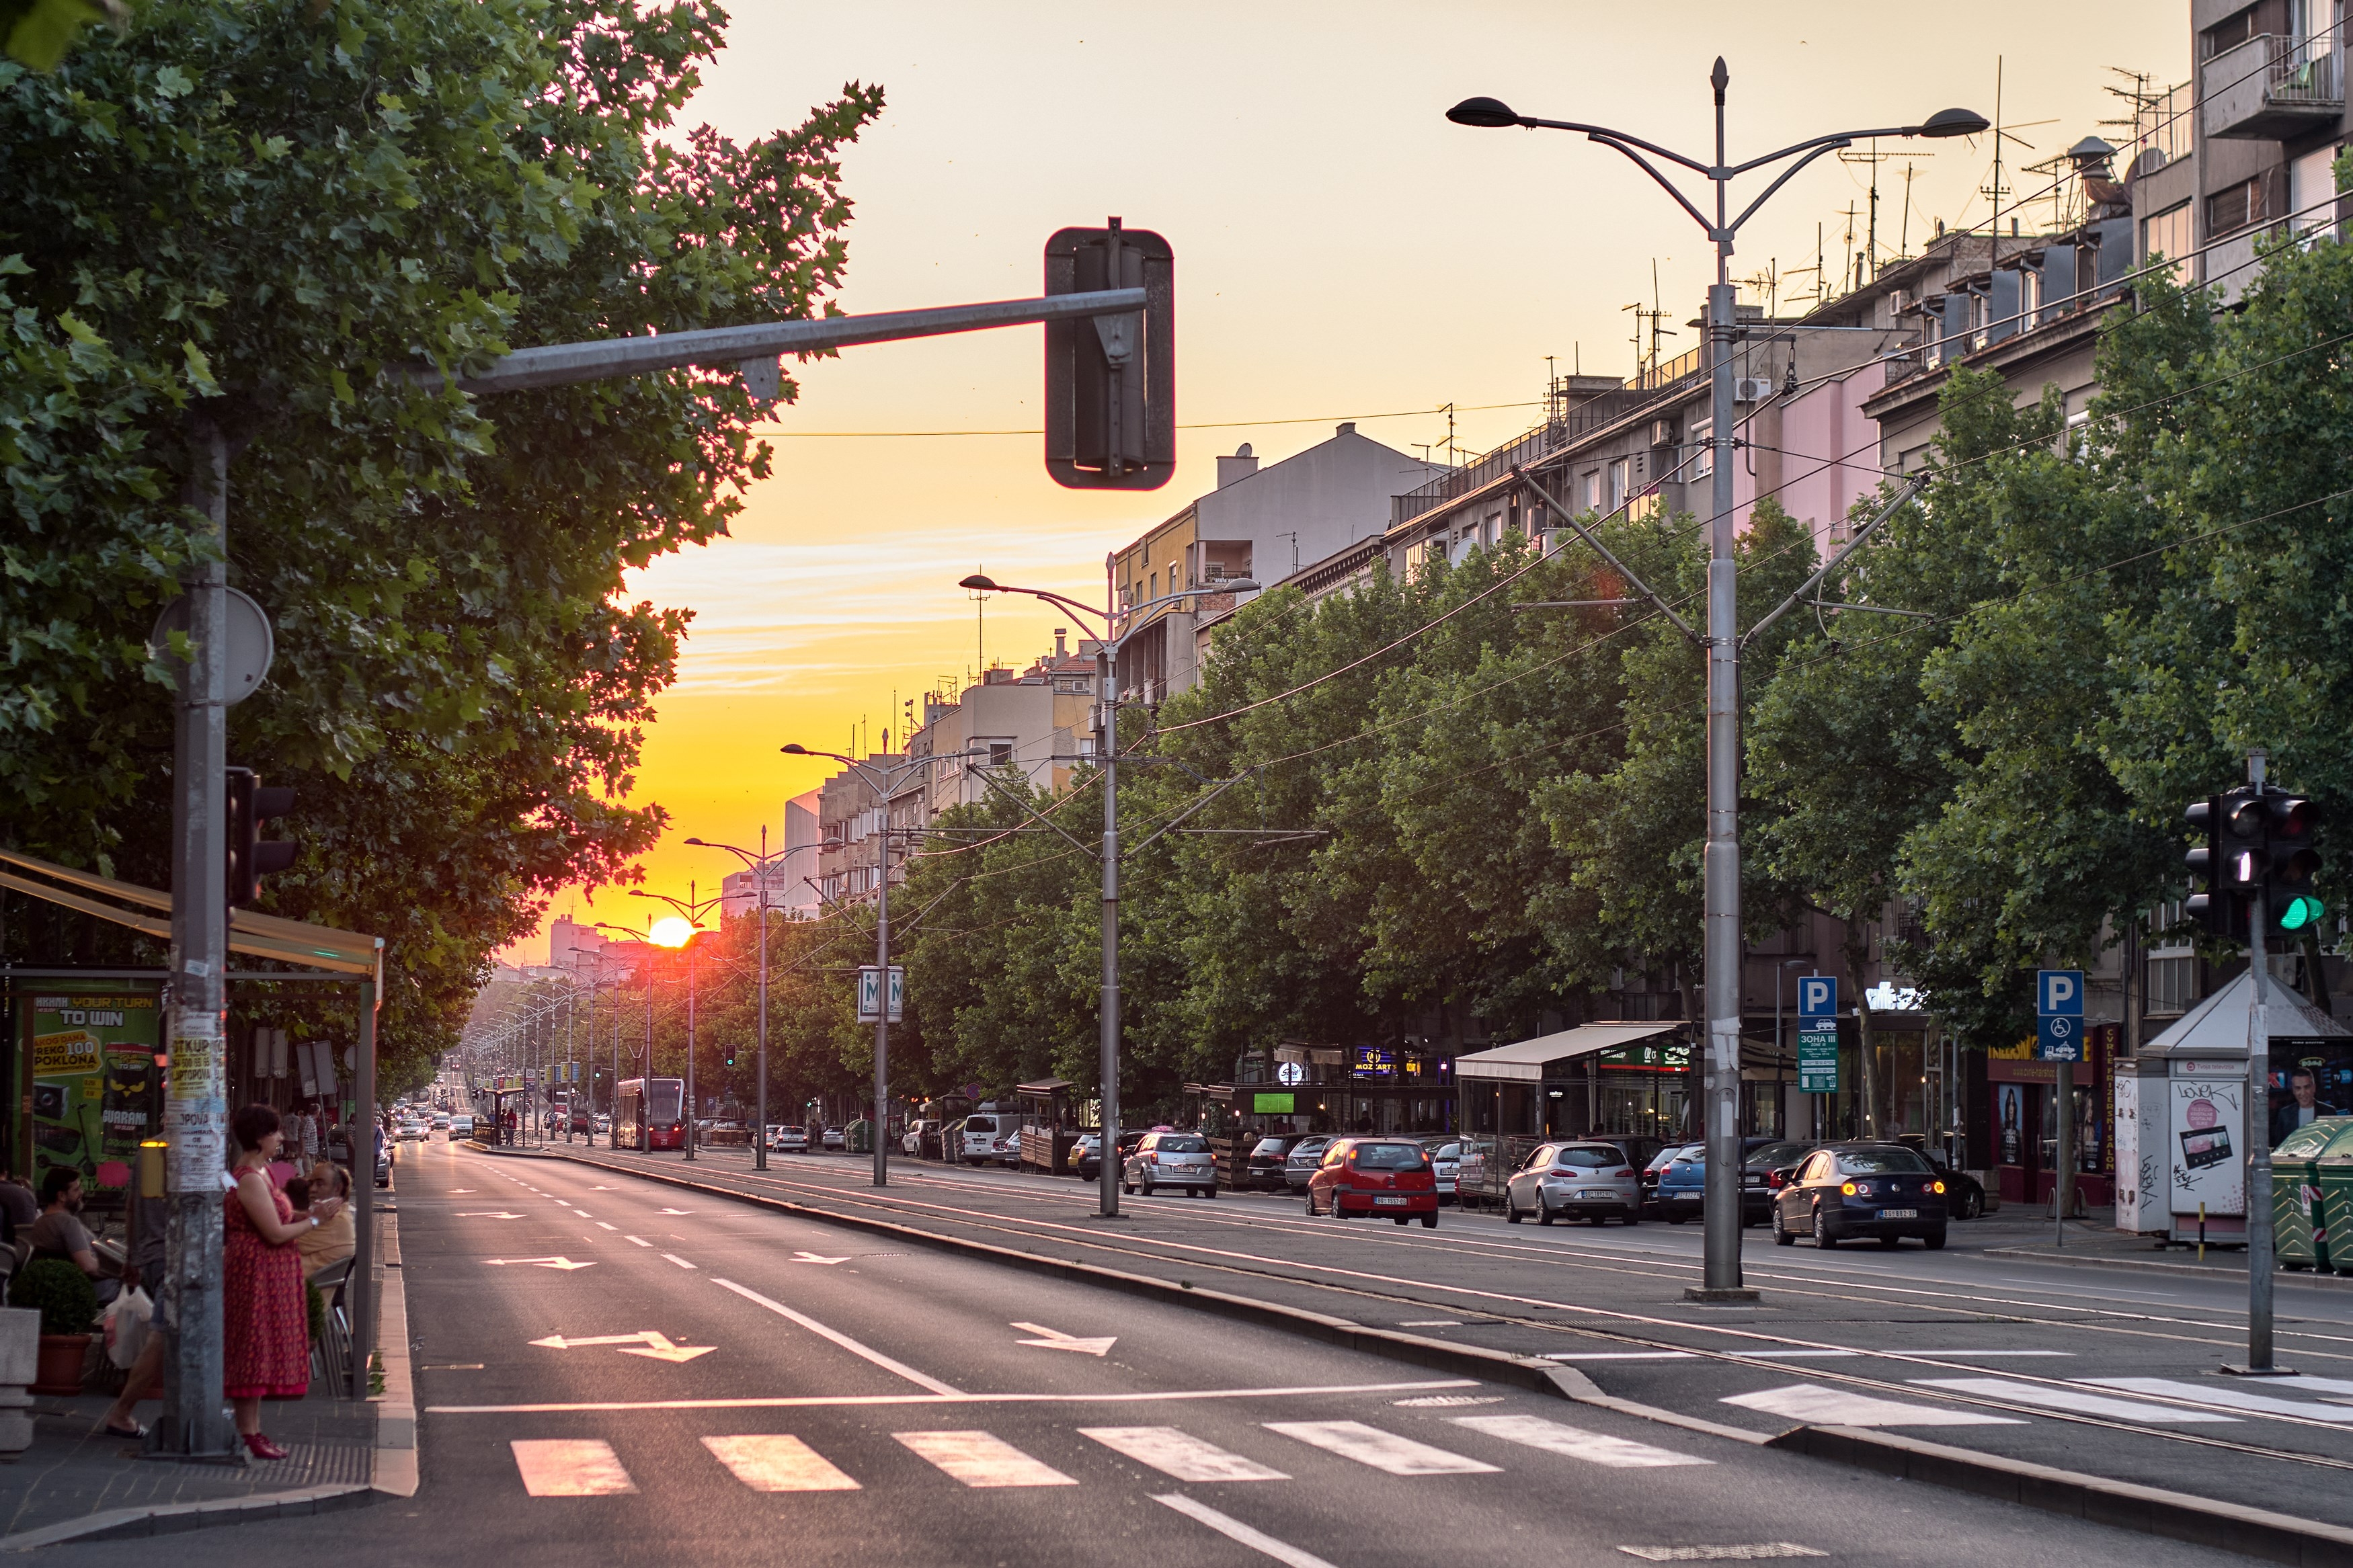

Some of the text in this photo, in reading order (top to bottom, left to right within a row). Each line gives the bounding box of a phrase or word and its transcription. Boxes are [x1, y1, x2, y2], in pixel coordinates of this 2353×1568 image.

[1807, 982, 1829, 1012] P
[2048, 976, 2073, 1010] P
[71, 997, 112, 1008] YOUR
[114, 997, 153, 1008] TURN
[60, 1009, 124, 1027] TO WIN
[61, 1034, 86, 1042] DANA
[34, 1041, 94, 1056] REKO 100
[34, 1055, 97, 1066] POKLONA
[2105, 1029, 2114, 1170] CVRLE FRIZERSKI SALON
[102, 1110, 148, 1126] GUARANA
